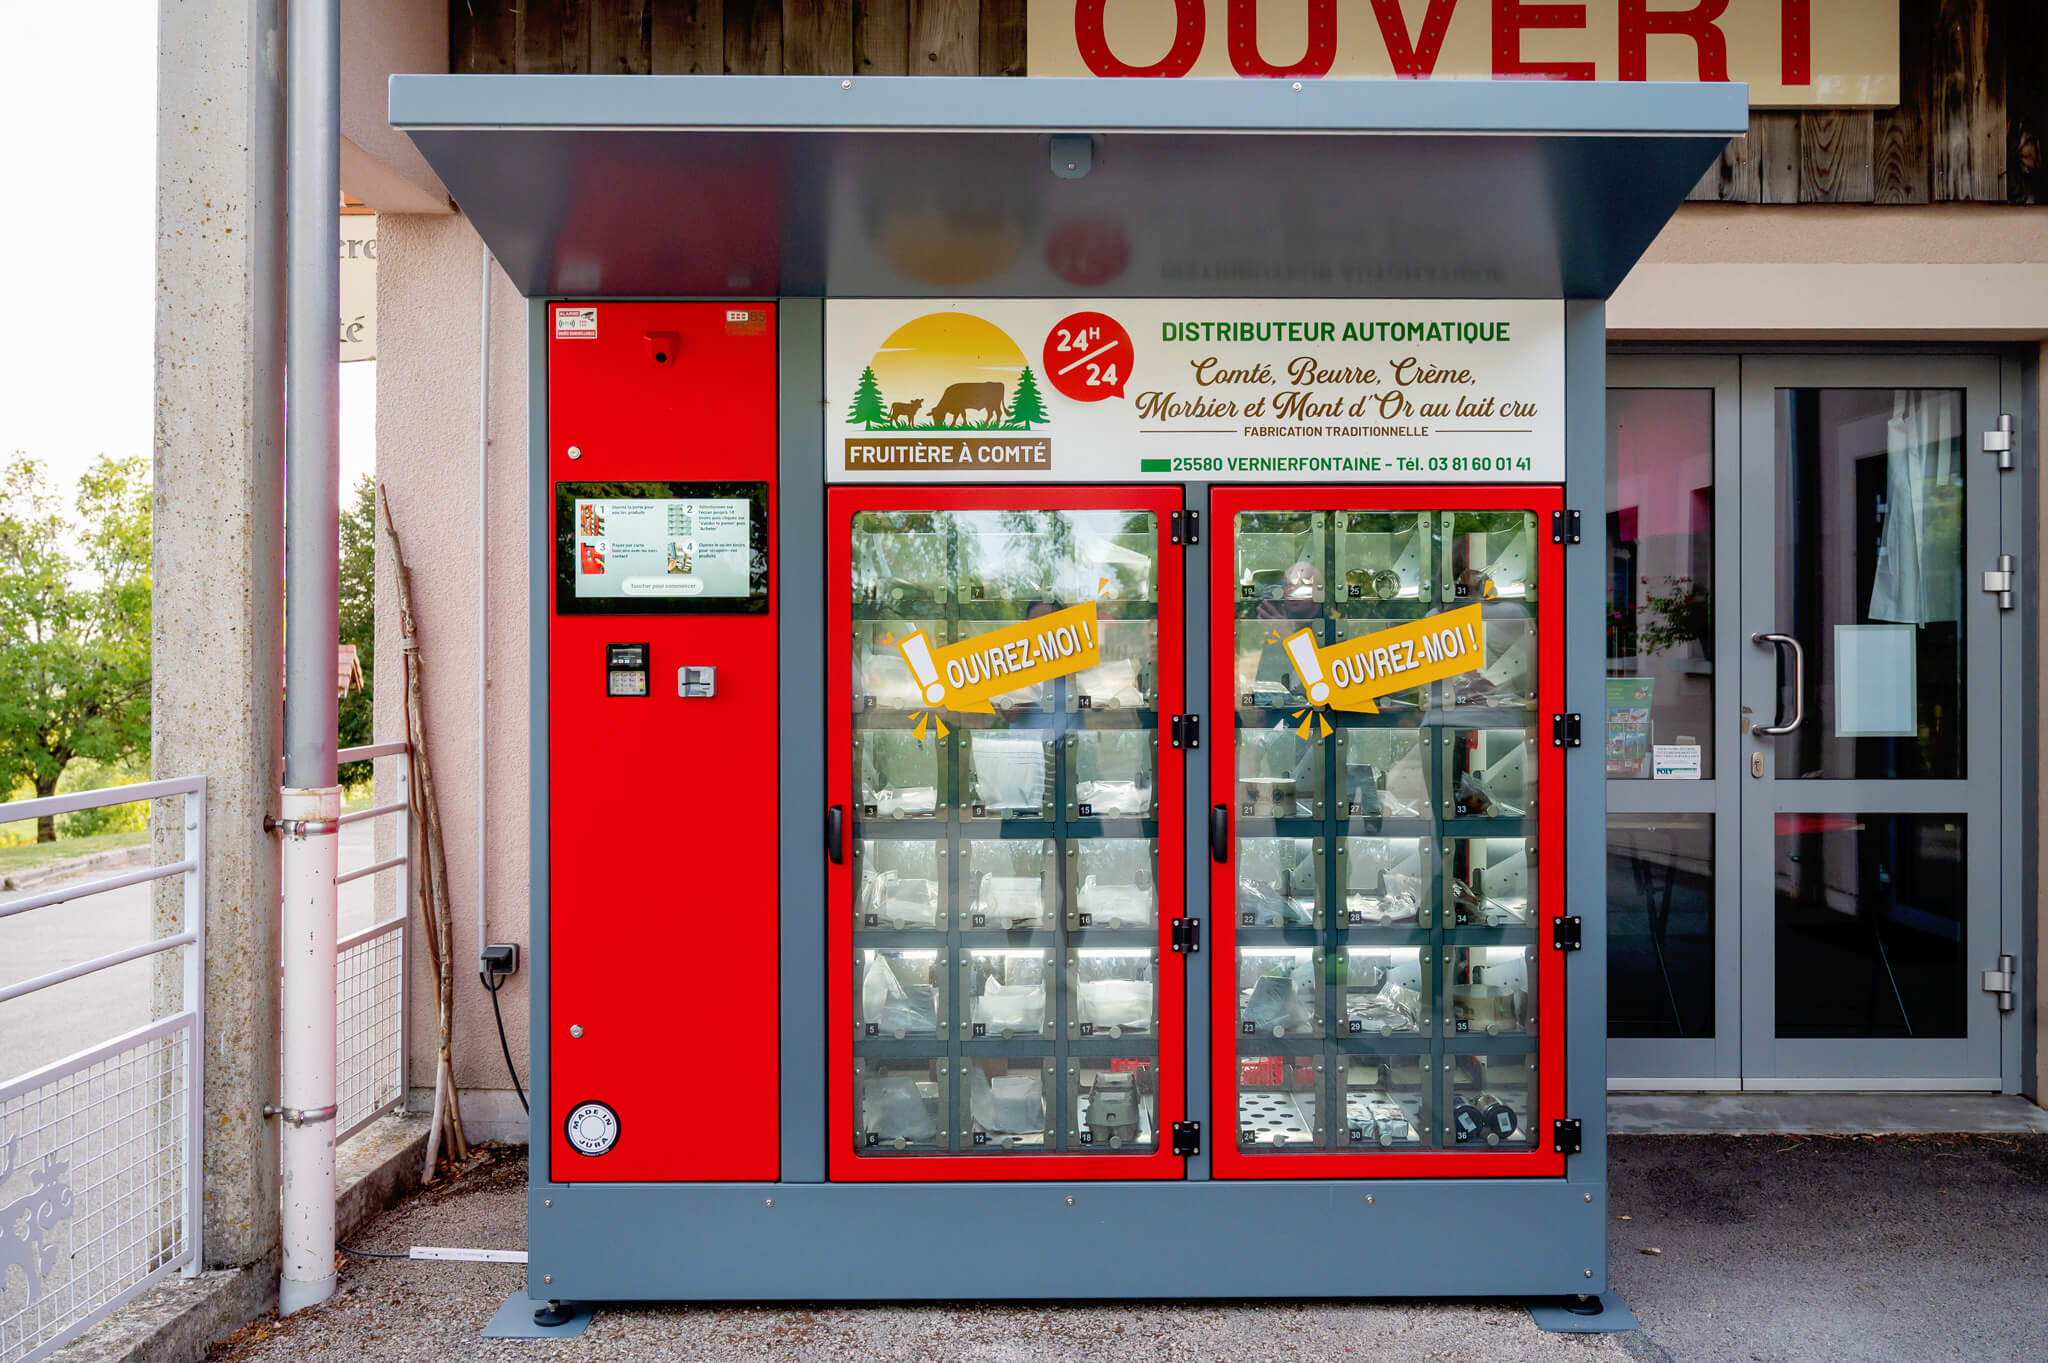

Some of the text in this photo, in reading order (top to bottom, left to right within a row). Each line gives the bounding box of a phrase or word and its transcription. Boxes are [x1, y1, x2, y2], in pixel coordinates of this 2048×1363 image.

[1162, 321, 1510, 344] DISTRIBUTEUR AUTOMATIQUE
[1190, 356, 1476, 386] Comté, Beurre, Crème,
[1135, 390, 1538, 421] Morbier et Mont d'Or au lait cru
[1244, 426, 1429, 437] FABRICATION TRADITIONNELLE
[850, 441, 1046, 463] FRUITIÈRE À COMTÉ
[1173, 457, 1223, 471] 25580
[1227, 457, 1381, 471] VERNIERFONTAINE
[1397, 457, 1424, 471] Tél.
[1428, 457, 1448, 471] 03
[1452, 457, 1468, 471] 81
[1471, 457, 1491, 471] 60
[1495, 457, 1512, 471] 01
[1516, 457, 1531, 471] 41
[686, 505, 693, 513] 2
[600, 543, 606, 551] 3
[686, 543, 693, 551] 4
[1350, 587, 1360, 595] 25
[1457, 586, 1466, 594] 31
[946, 625, 1081, 689] OUVREZ-MOI
[1331, 626, 1466, 688] OUVREZ-MOI
[1080, 698, 1089, 706] 14
[1243, 696, 1253, 704] 20
[1456, 696, 1467, 704] 32
[1080, 806, 1090, 814] 15
[1457, 805, 1467, 813] 33
[974, 916, 984, 924] 10
[1350, 913, 1360, 921] 28
[1457, 914, 1467, 922] 34
[975, 1025, 984, 1034] 11
[1081, 1025, 1091, 1033] 17
[1350, 1022, 1360, 1031] 29
[1457, 1022, 1467, 1031] 35
[573, 1109, 612, 1130] MADE IN
[975, 1135, 985, 1143] 12
[1081, 1133, 1091, 1141] 18
[1351, 1131, 1361, 1139] 30
[1457, 1131, 1467, 1139] 36
[578, 1137, 609, 1148] JURA
